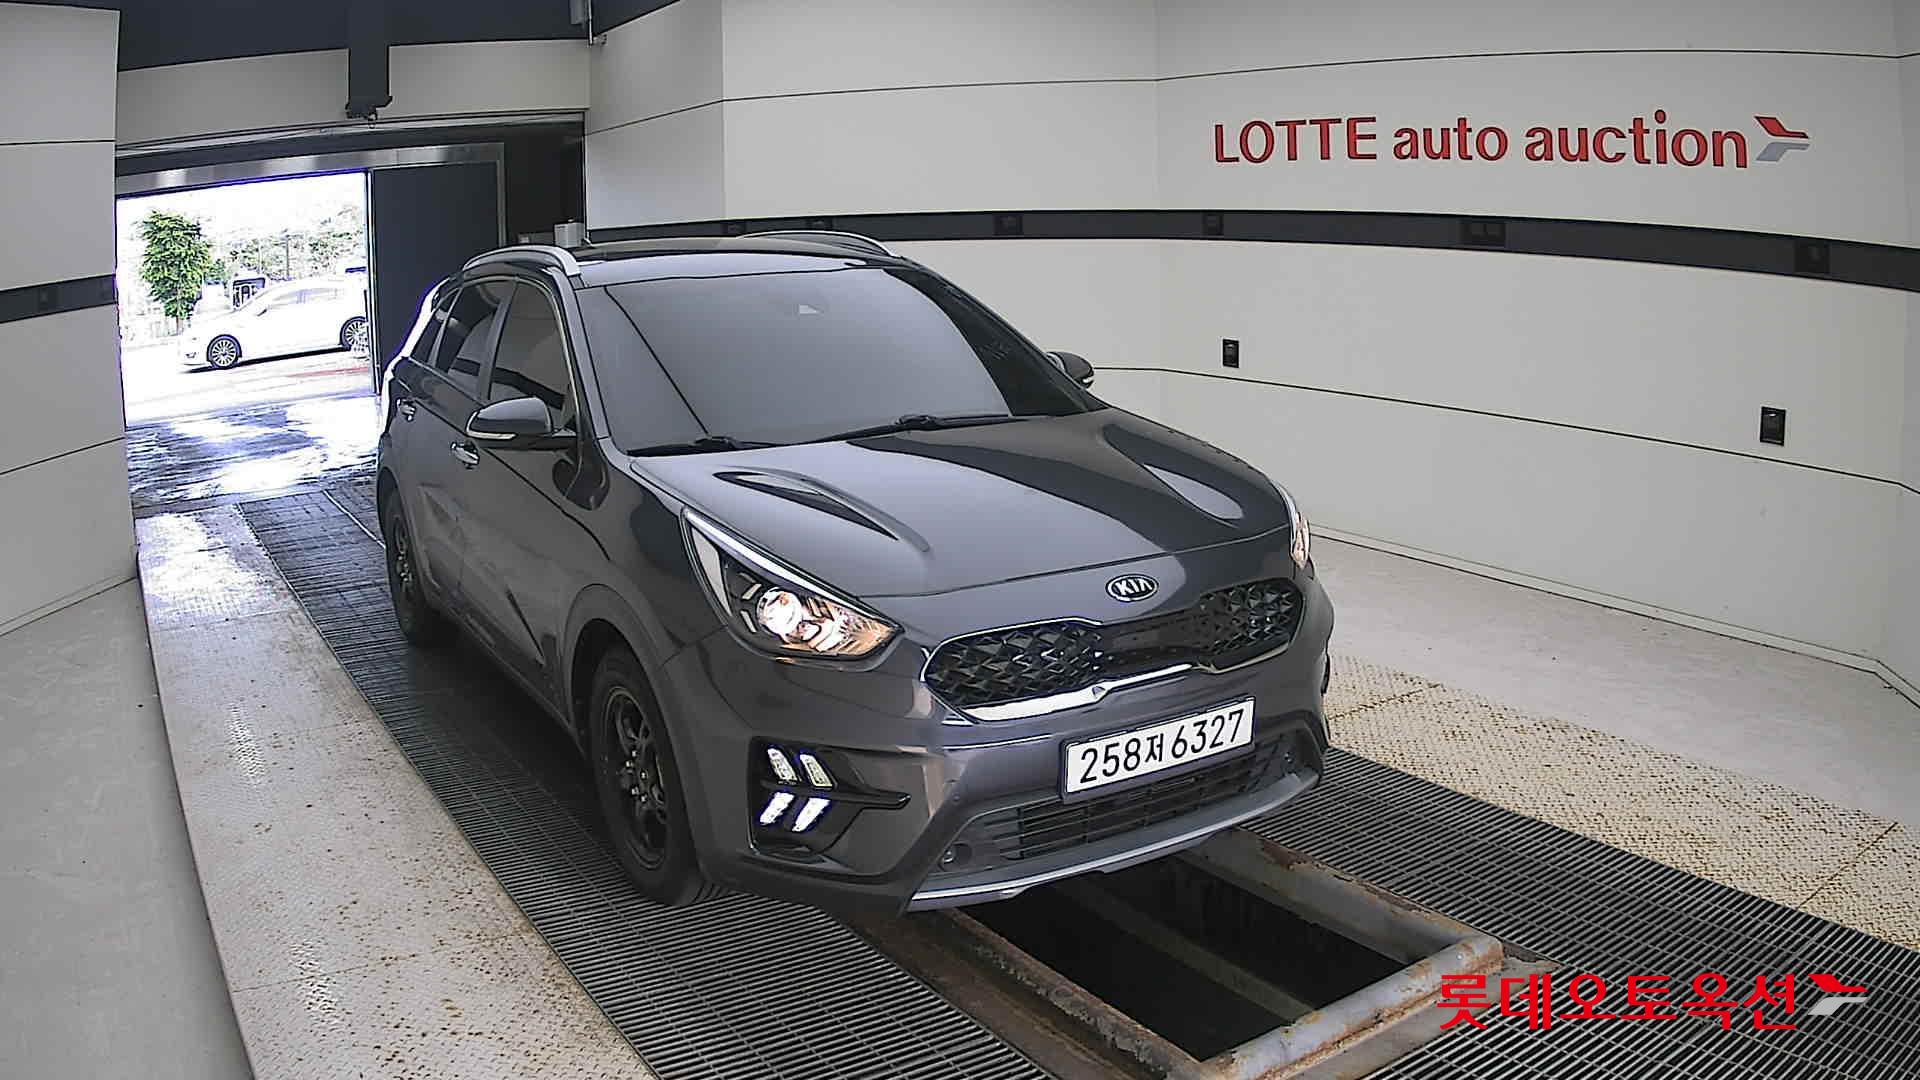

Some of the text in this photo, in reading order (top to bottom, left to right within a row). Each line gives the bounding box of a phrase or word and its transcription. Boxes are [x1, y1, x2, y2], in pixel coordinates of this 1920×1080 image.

[1214, 109, 1749, 169] LOTTE auto auction
[1114, 578, 1153, 596] KIA
